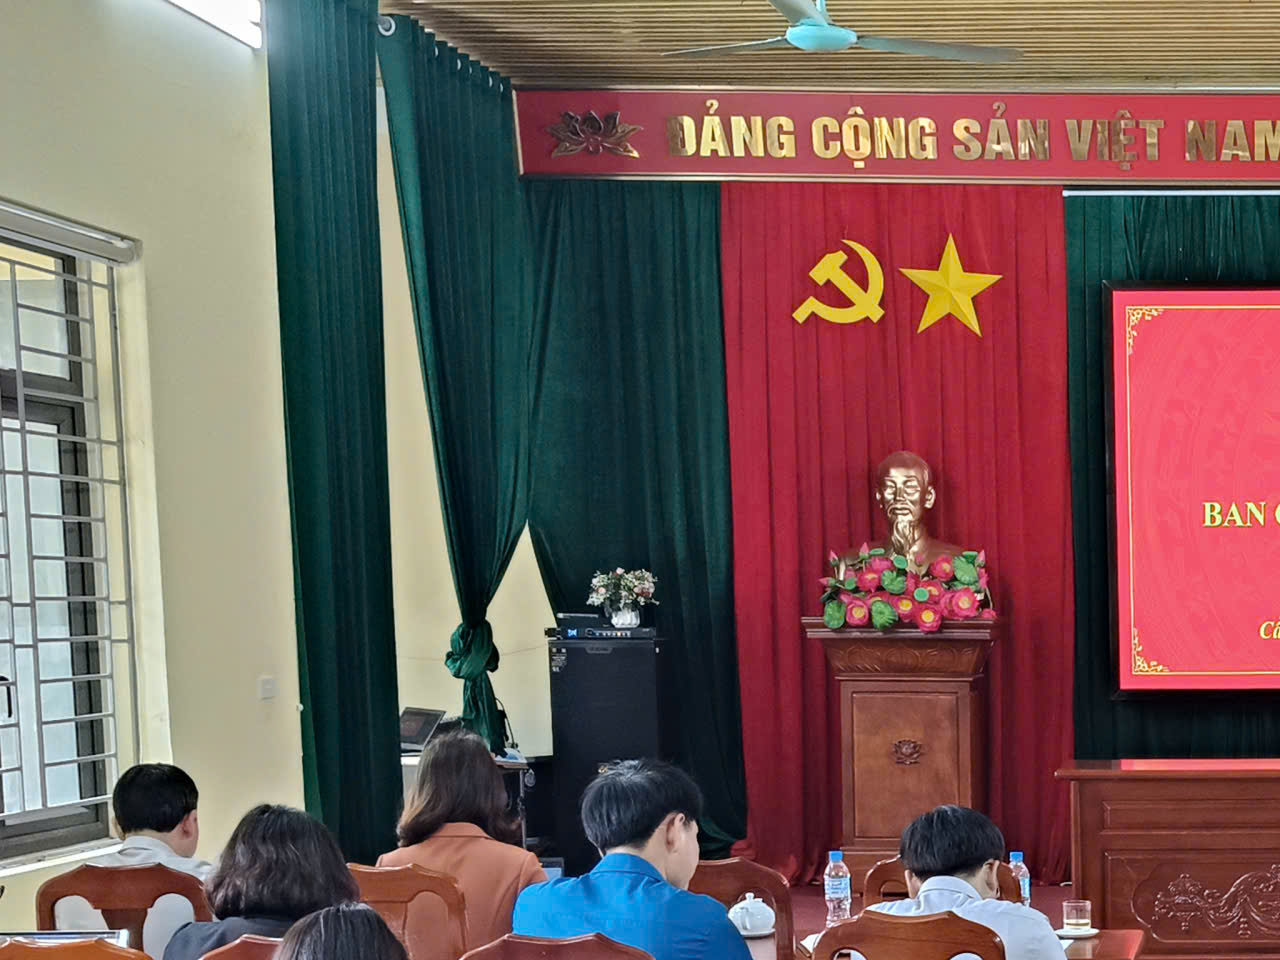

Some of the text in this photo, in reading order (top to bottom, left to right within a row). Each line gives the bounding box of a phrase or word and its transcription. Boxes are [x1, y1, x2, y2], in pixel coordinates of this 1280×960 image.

[667, 99, 796, 158] ĐẢNG
[811, 106, 938, 168] CỘNG
[953, 102, 1051, 161] SẢN
[1065, 108, 1165, 171] VIỆT
[1202, 501, 1267, 528] BAN
